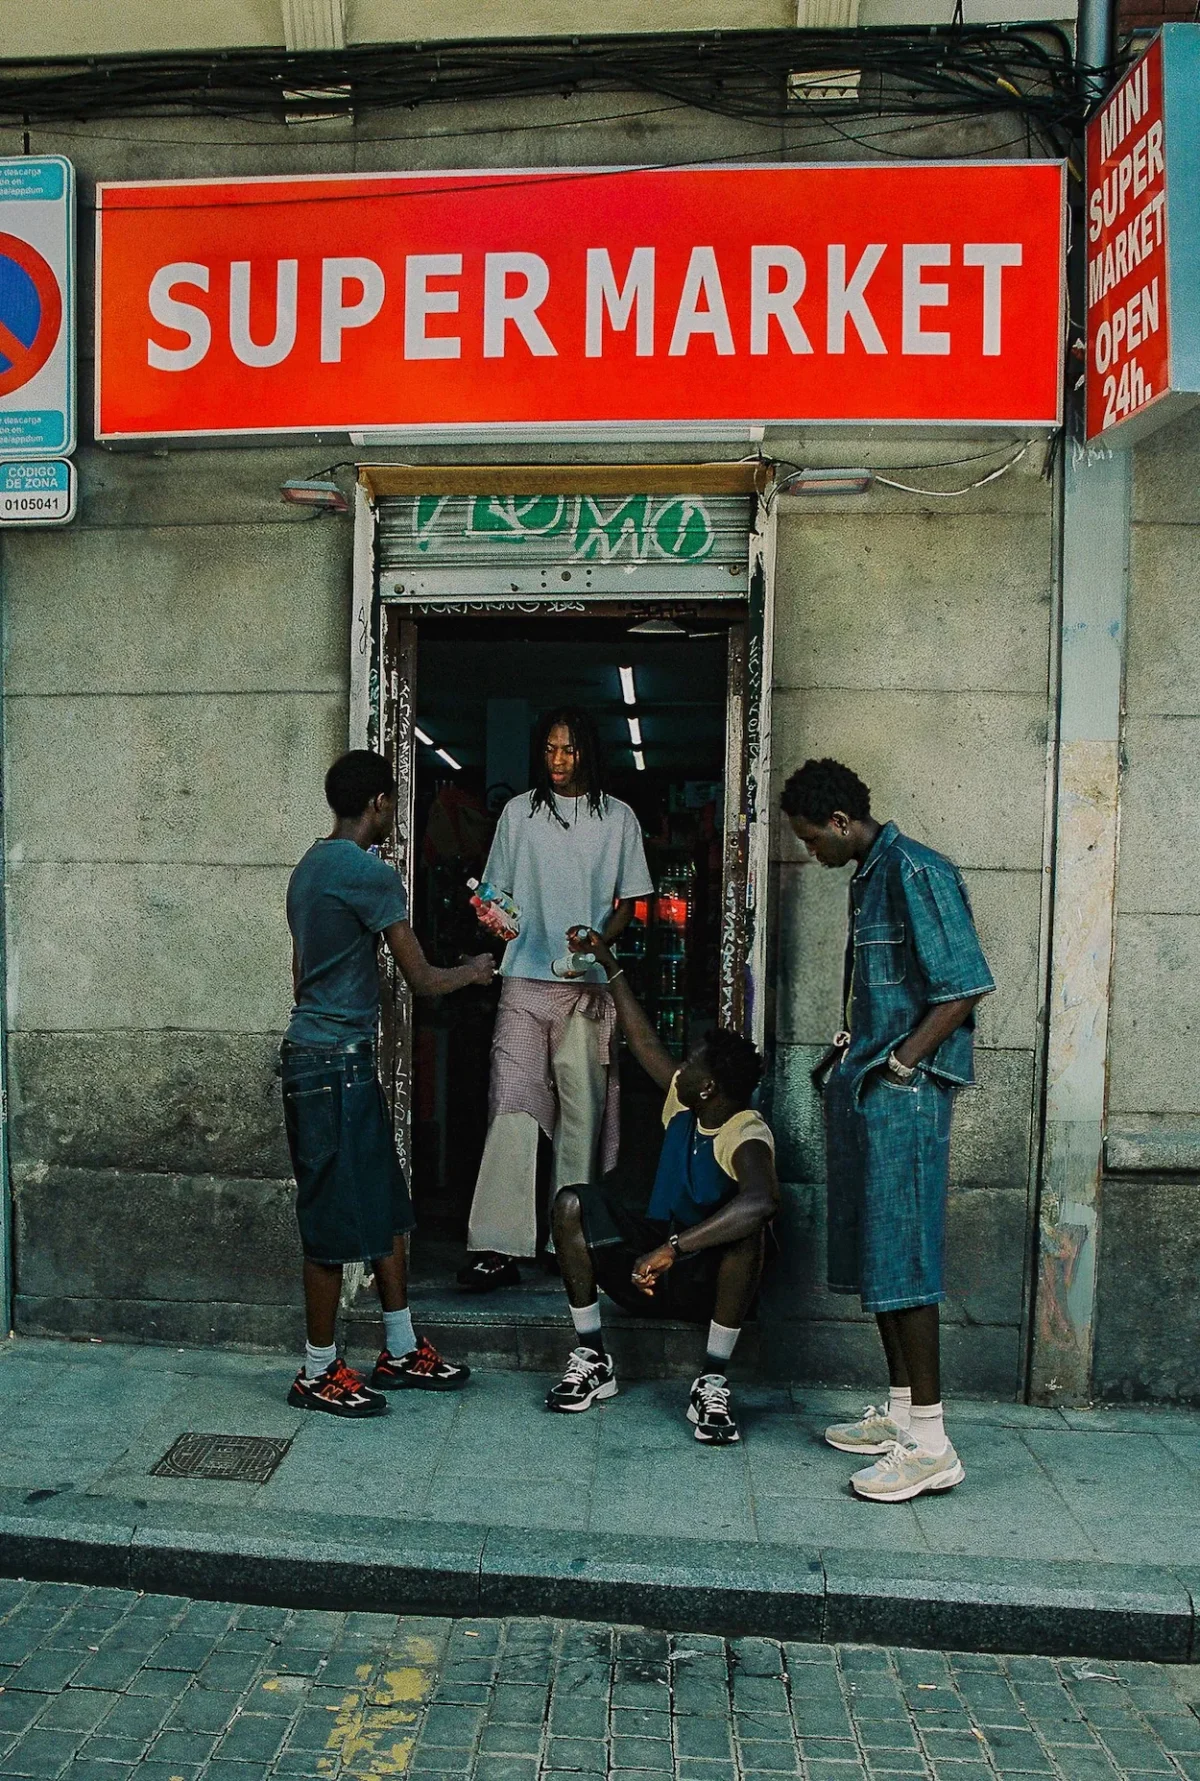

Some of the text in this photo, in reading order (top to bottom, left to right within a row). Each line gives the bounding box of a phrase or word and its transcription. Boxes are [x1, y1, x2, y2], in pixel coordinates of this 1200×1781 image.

[1100, 57, 1149, 166] MINI
[1089, 119, 1165, 243] SUPER
[1089, 188, 1165, 309] MARKET
[147, 243, 1023, 372] SUPER MARKET
[1095, 276, 1159, 375] OPEN
[1102, 356, 1152, 430] 24h.
[5, 477, 59, 489] DE ZONA
[5, 497, 59, 511] 0105041
[8, 465, 57, 478] CÓDIGO
